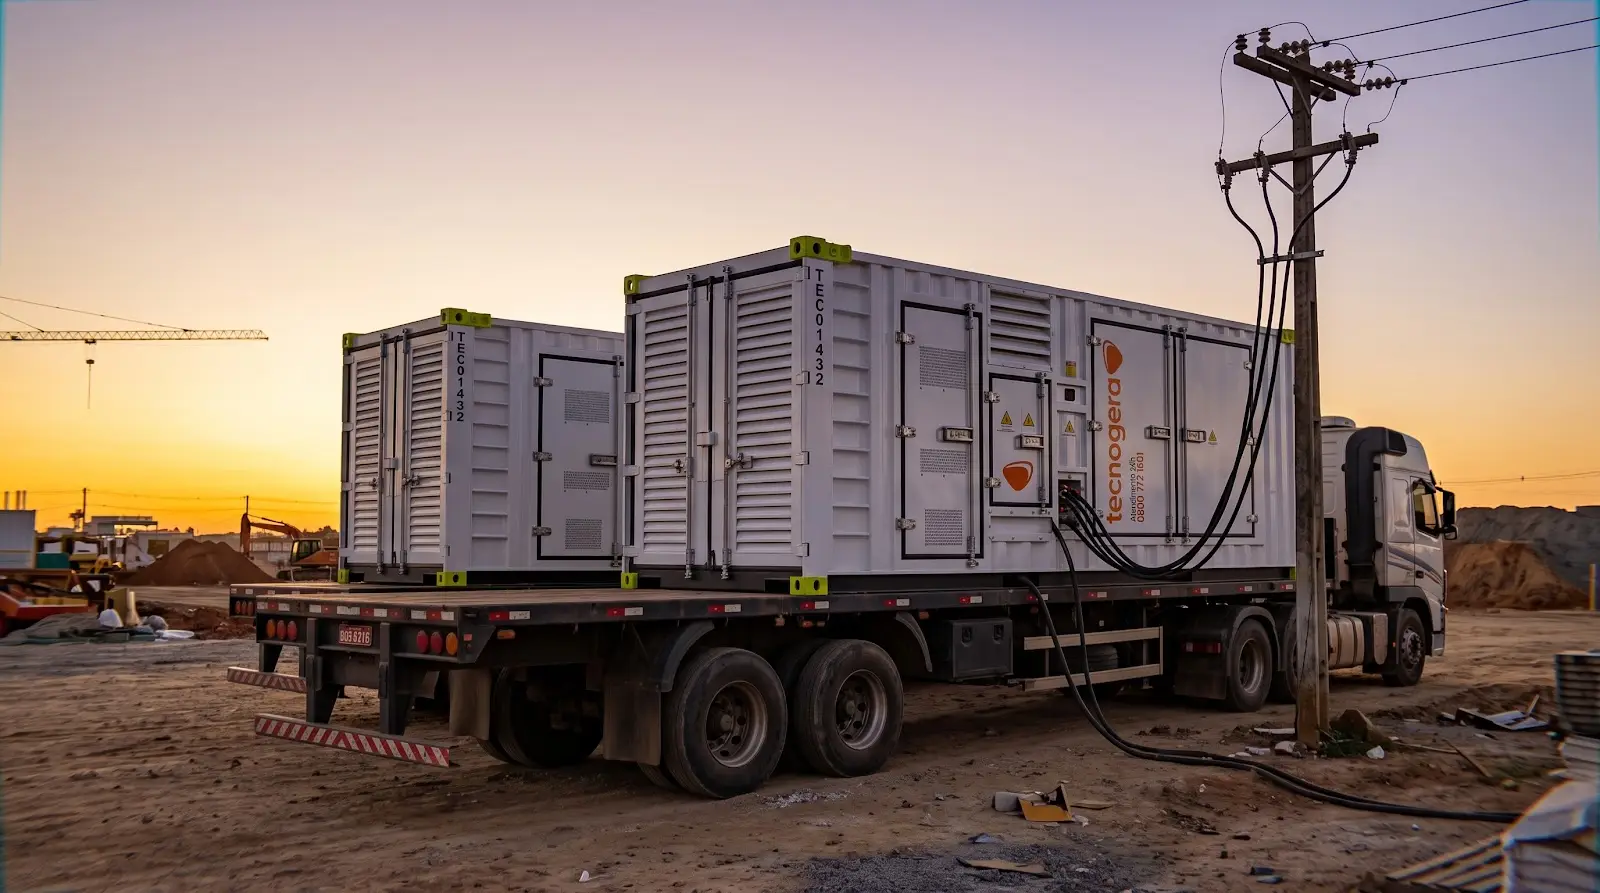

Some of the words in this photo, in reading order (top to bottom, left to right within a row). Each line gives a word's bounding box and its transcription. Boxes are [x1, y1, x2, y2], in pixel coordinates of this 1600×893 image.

[815, 268, 825, 386] TEC01432
[456, 331, 466, 422] TEC01432
[1106, 378, 1126, 524] tecnogera
[1136, 452, 1144, 473] 1601
[1136, 475, 1144, 492] 772
[1136, 495, 1145, 523] 0800
